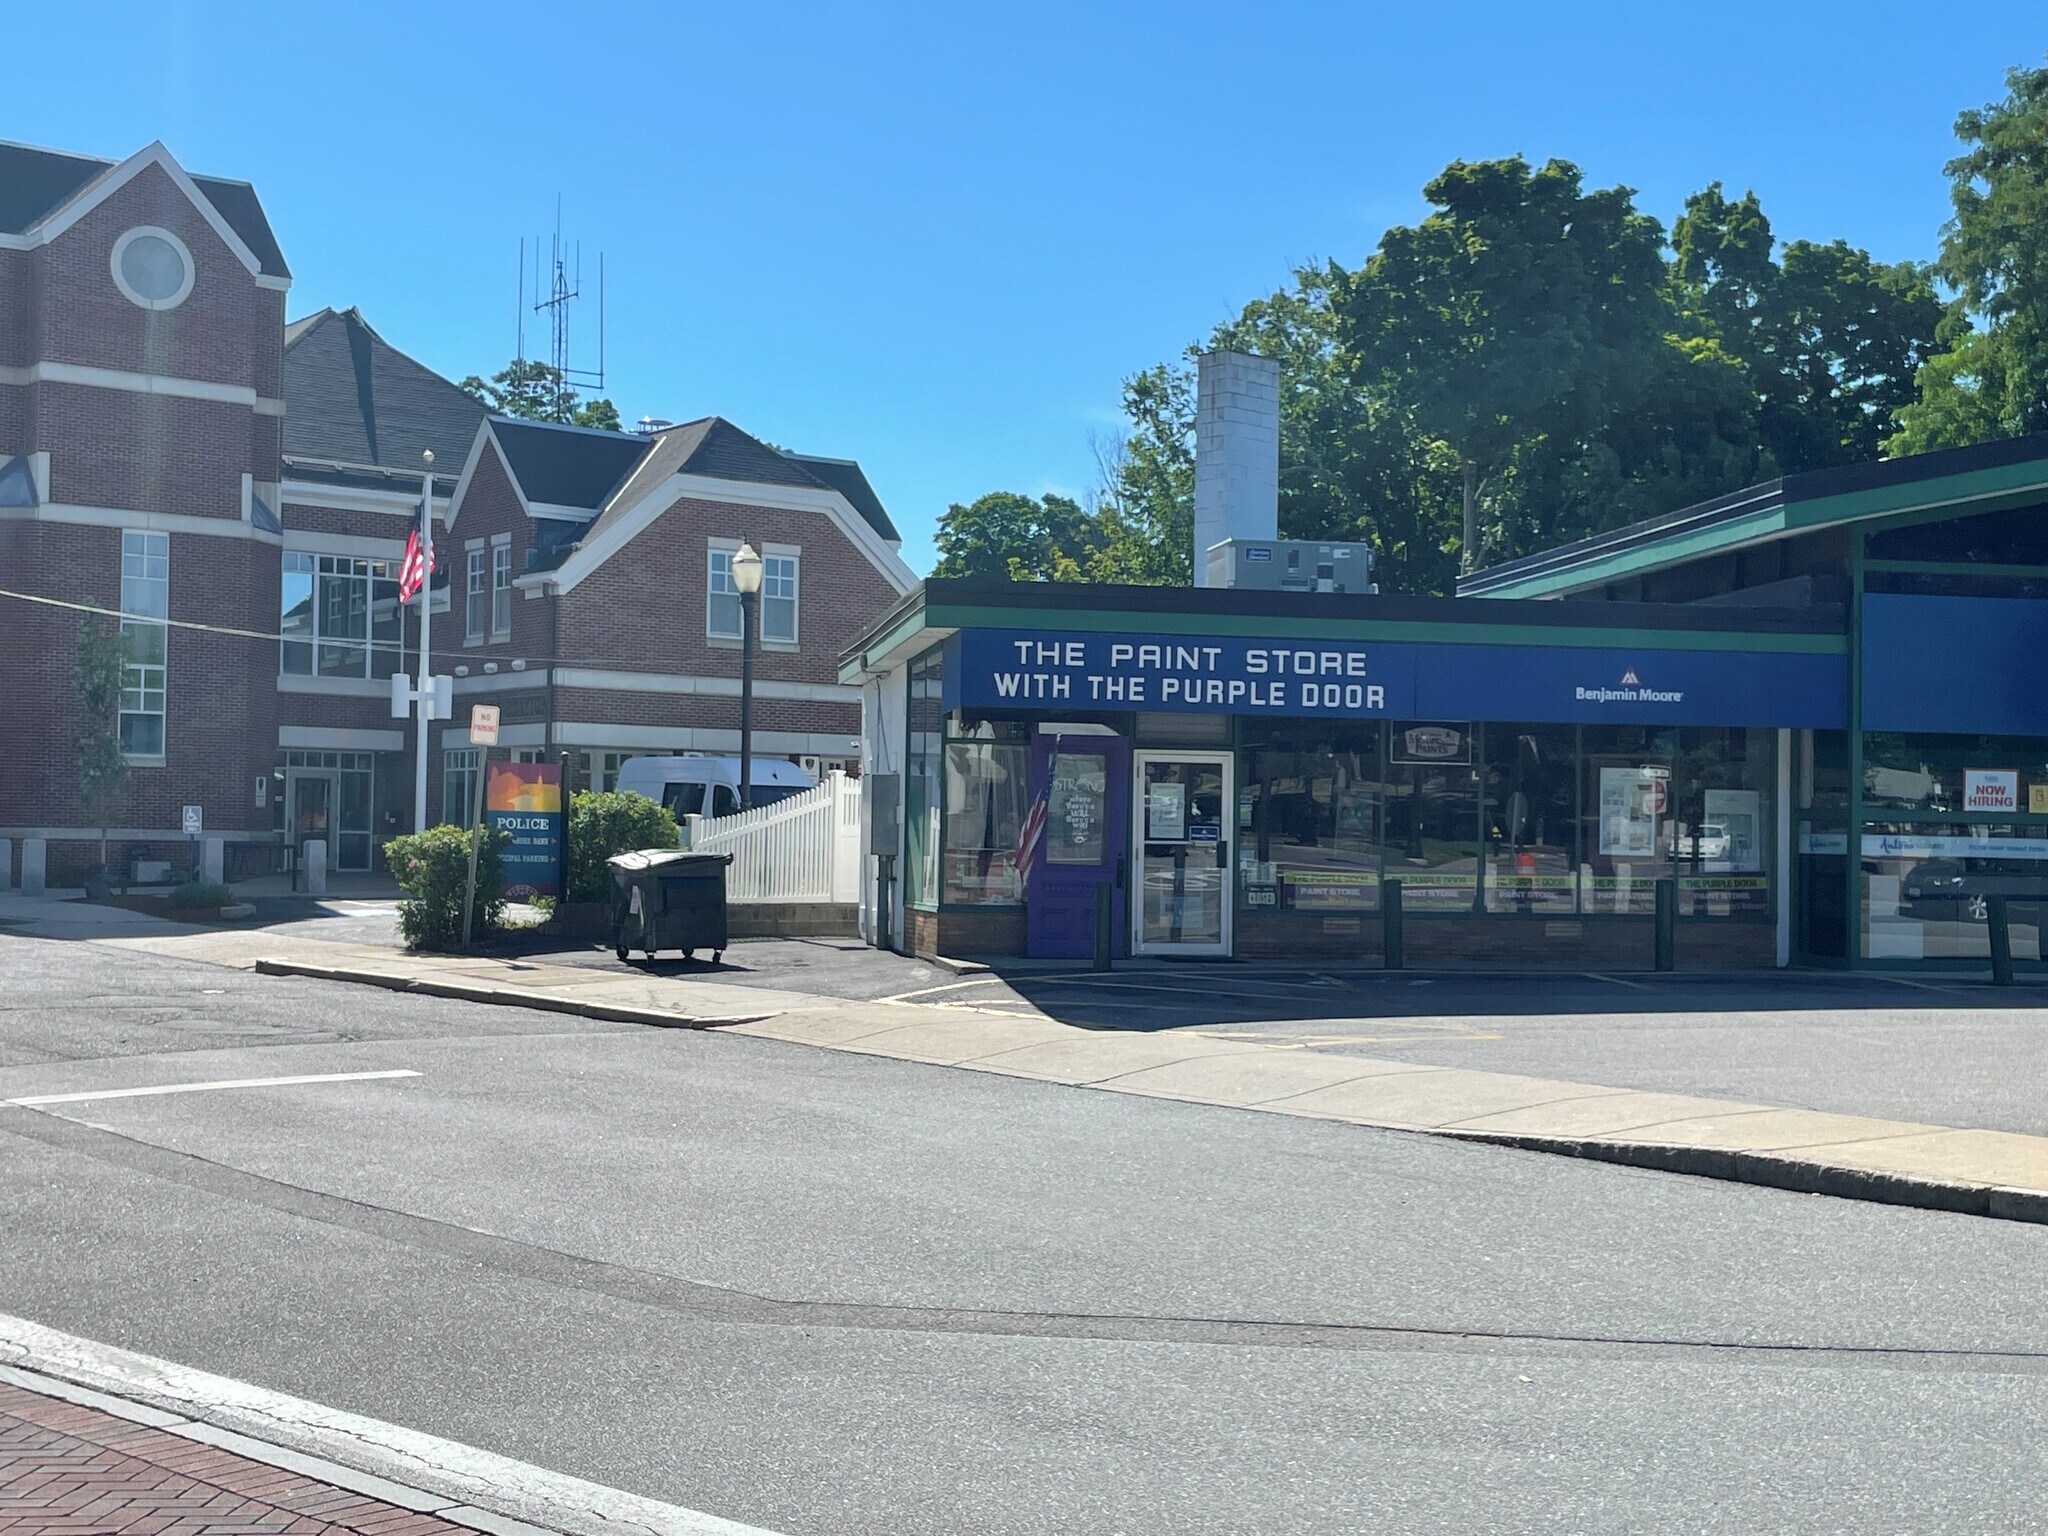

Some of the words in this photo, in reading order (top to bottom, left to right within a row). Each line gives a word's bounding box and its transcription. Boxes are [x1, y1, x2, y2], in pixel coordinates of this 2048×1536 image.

[1014, 641, 1085, 667] THE
[1111, 644, 1222, 671] PAINT
[1246, 649, 1366, 677] STORE
[993, 672, 1070, 698] WITH
[1087, 676, 1145, 701] THE
[1162, 677, 1286, 707] PURPLE
[1302, 683, 1385, 709] DOOR
[1576, 687, 1636, 703] Benjamin
[1639, 688, 1682, 702] Moore
[480, 713, 491, 722] NO
[473, 724, 497, 732] PARKING
[1976, 785, 2006, 796] NOW
[1968, 796, 2013, 807] HIRING
[496, 817, 549, 830] POLICE
[523, 855, 549, 863] PARKING
[1509, 878, 1541, 887] PURPLE
[1542, 878, 1566, 887] DOOR
[1685, 880, 1701, 888] THE
[1702, 880, 1733, 888] PURPLE
[1734, 880, 1757, 888] DOOR
[1300, 887, 1328, 896] PAINT
[1329, 888, 1361, 897] STORE
[1499, 891, 1526, 899] PAINT
[1527, 891, 1559, 900] STORE
[1693, 892, 1719, 900] PAINT
[1720, 892, 1750, 900] STORE
[1248, 892, 1276, 905] CLOSED
